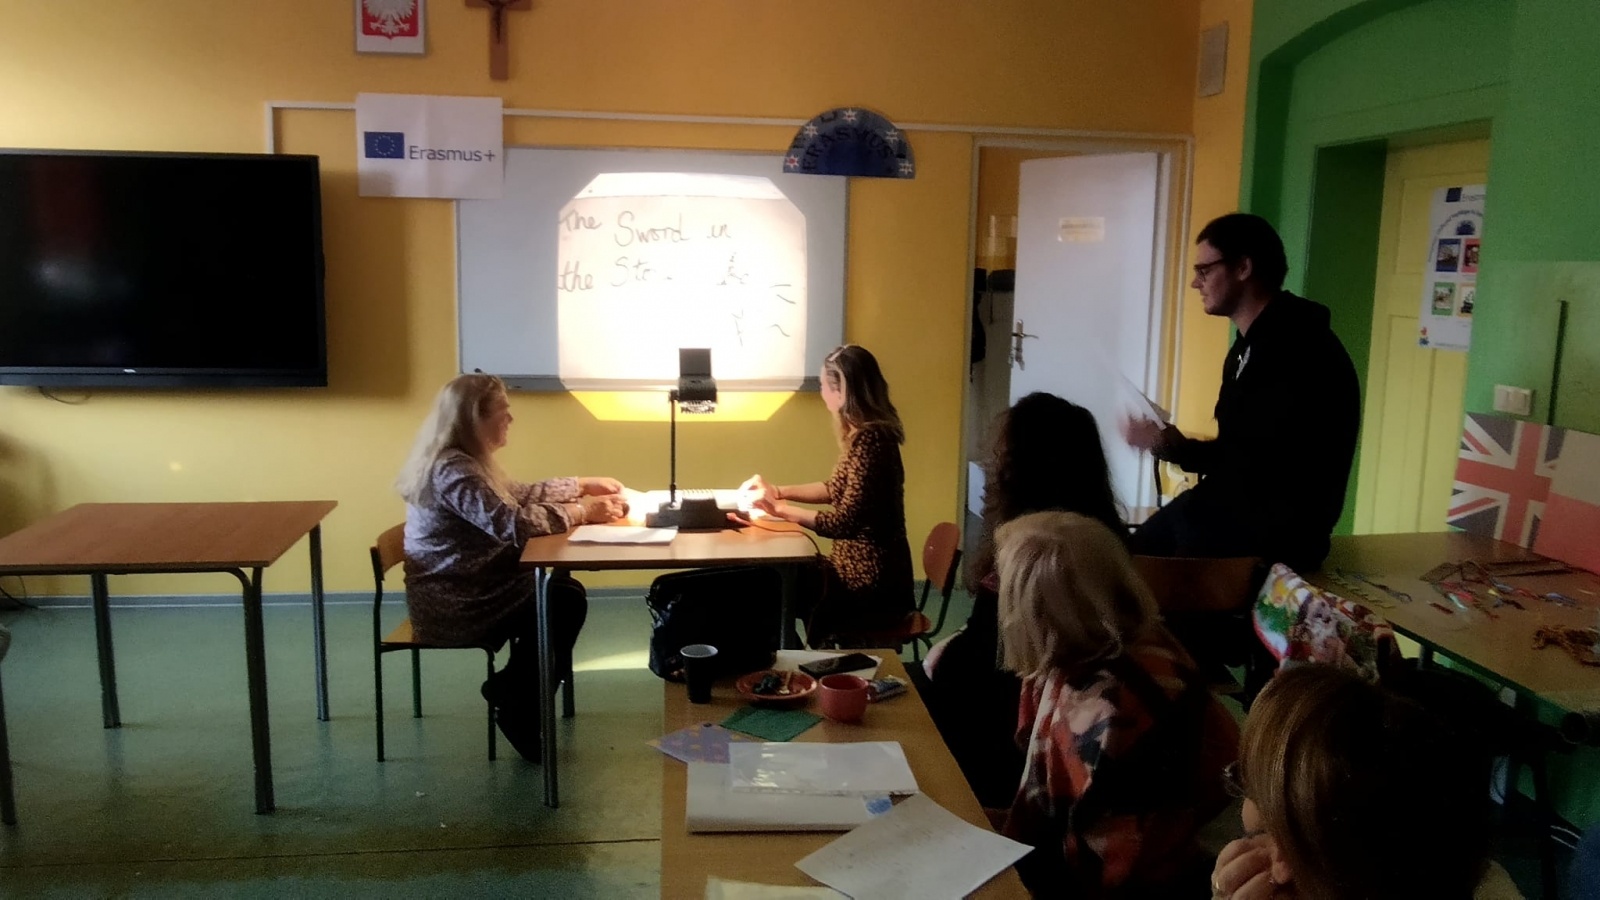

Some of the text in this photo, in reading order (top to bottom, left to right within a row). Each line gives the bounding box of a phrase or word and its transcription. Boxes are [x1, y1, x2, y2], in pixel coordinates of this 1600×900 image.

[409, 145, 496, 162] Erasmus+
[559, 209, 602, 232] The
[613, 210, 690, 247] Sword
[557, 260, 594, 292] the
